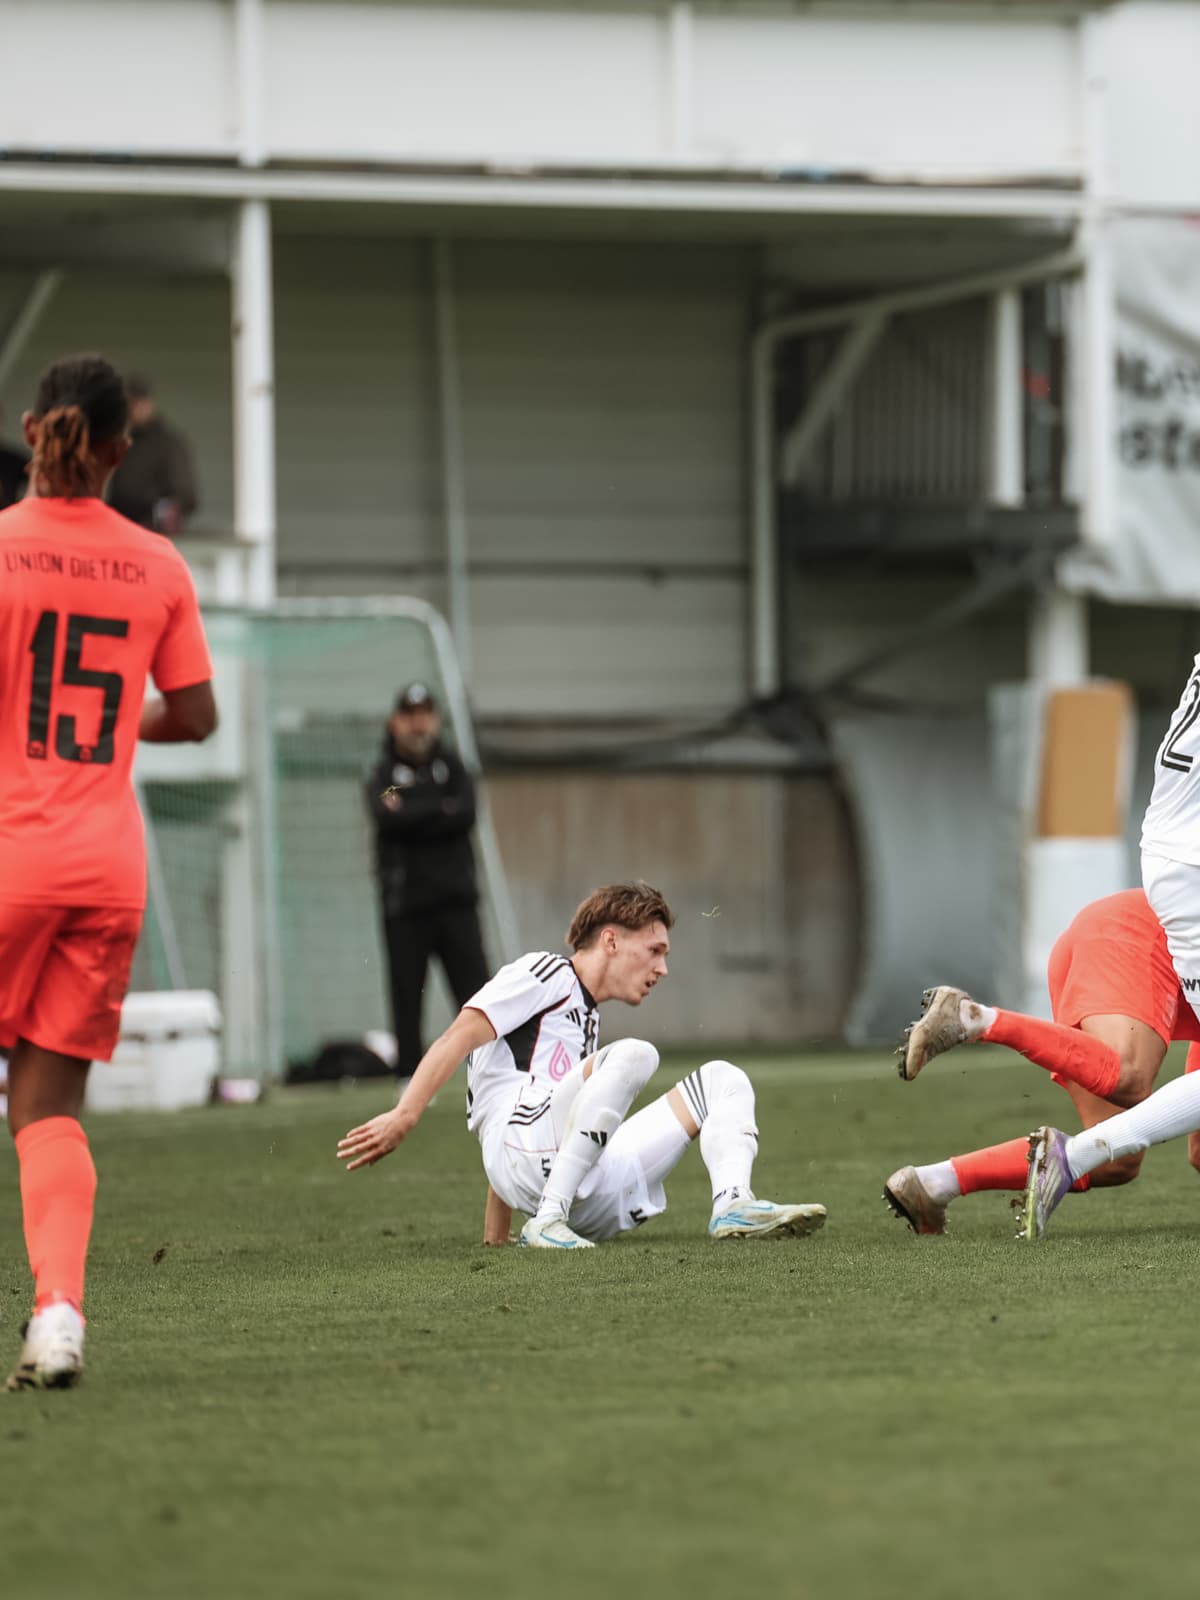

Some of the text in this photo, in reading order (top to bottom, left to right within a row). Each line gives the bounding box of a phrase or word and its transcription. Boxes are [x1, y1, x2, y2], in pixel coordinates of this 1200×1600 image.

[6, 552, 147, 584] UNION DIETACH
[27, 610, 129, 766] 15
